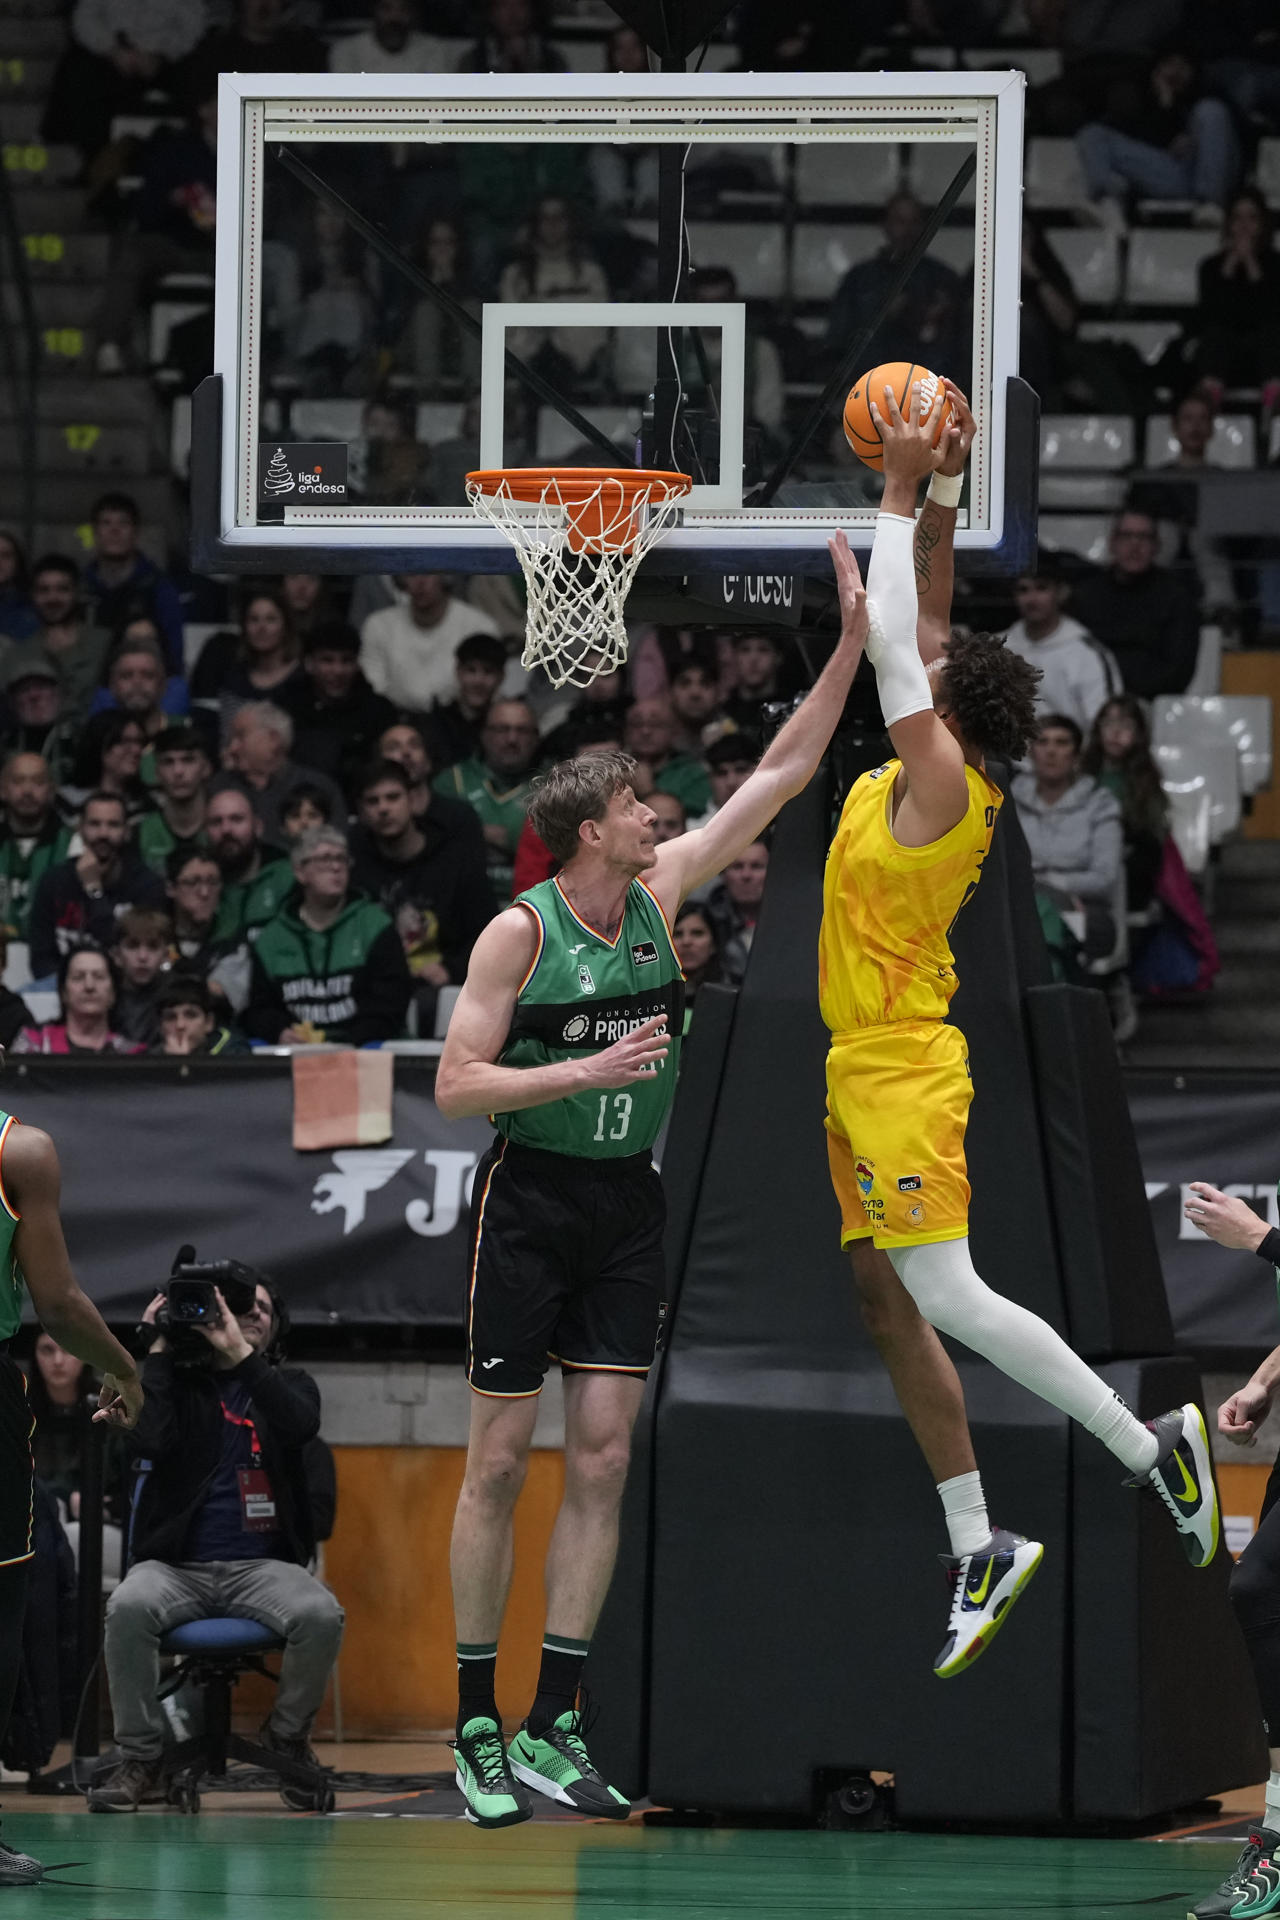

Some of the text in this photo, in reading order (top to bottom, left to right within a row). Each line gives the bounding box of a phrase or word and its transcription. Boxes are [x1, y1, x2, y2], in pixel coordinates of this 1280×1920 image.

[22, 234, 64, 261] 19
[65, 426, 101, 450] 17
[298, 472, 320, 484] liga
[298, 483, 345, 494] endesa
[593, 1093, 633, 1141] 13
[900, 1181, 917, 1190] acb
